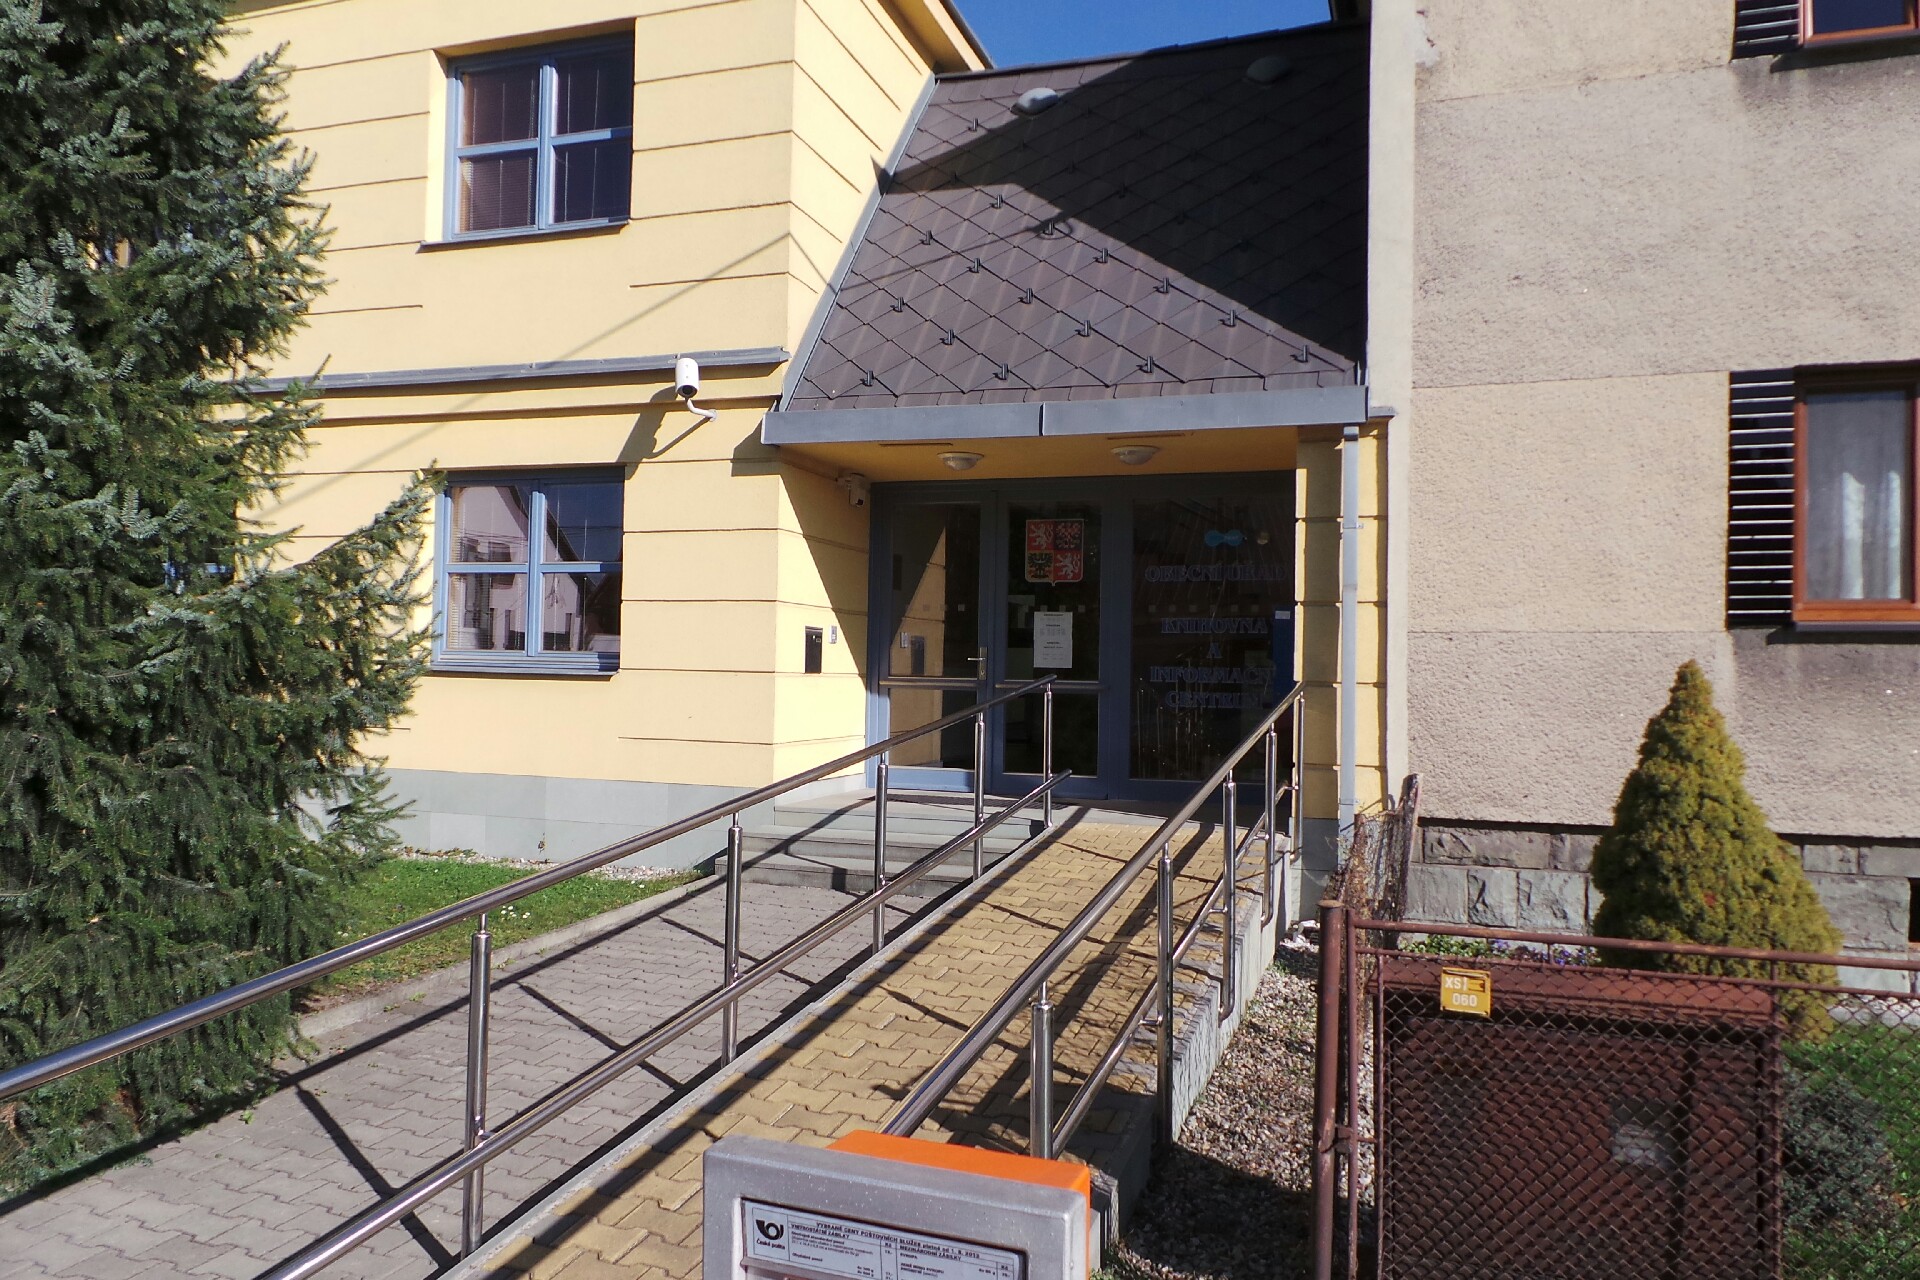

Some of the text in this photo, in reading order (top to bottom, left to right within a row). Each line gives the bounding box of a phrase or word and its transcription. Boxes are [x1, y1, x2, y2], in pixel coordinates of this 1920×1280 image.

[1144, 561, 1225, 582] OBECNÍ
[1160, 618, 1268, 634] KNIHOVNA
[1206, 642, 1223, 659] A
[1165, 691, 1263, 709] CENTRUM
[1452, 993, 1477, 1007] 060
[816, 1222, 843, 1232] VYBRANÉ
[843, 1227, 861, 1236] CENY
[861, 1230, 898, 1243] POŠTOVNÍCH
